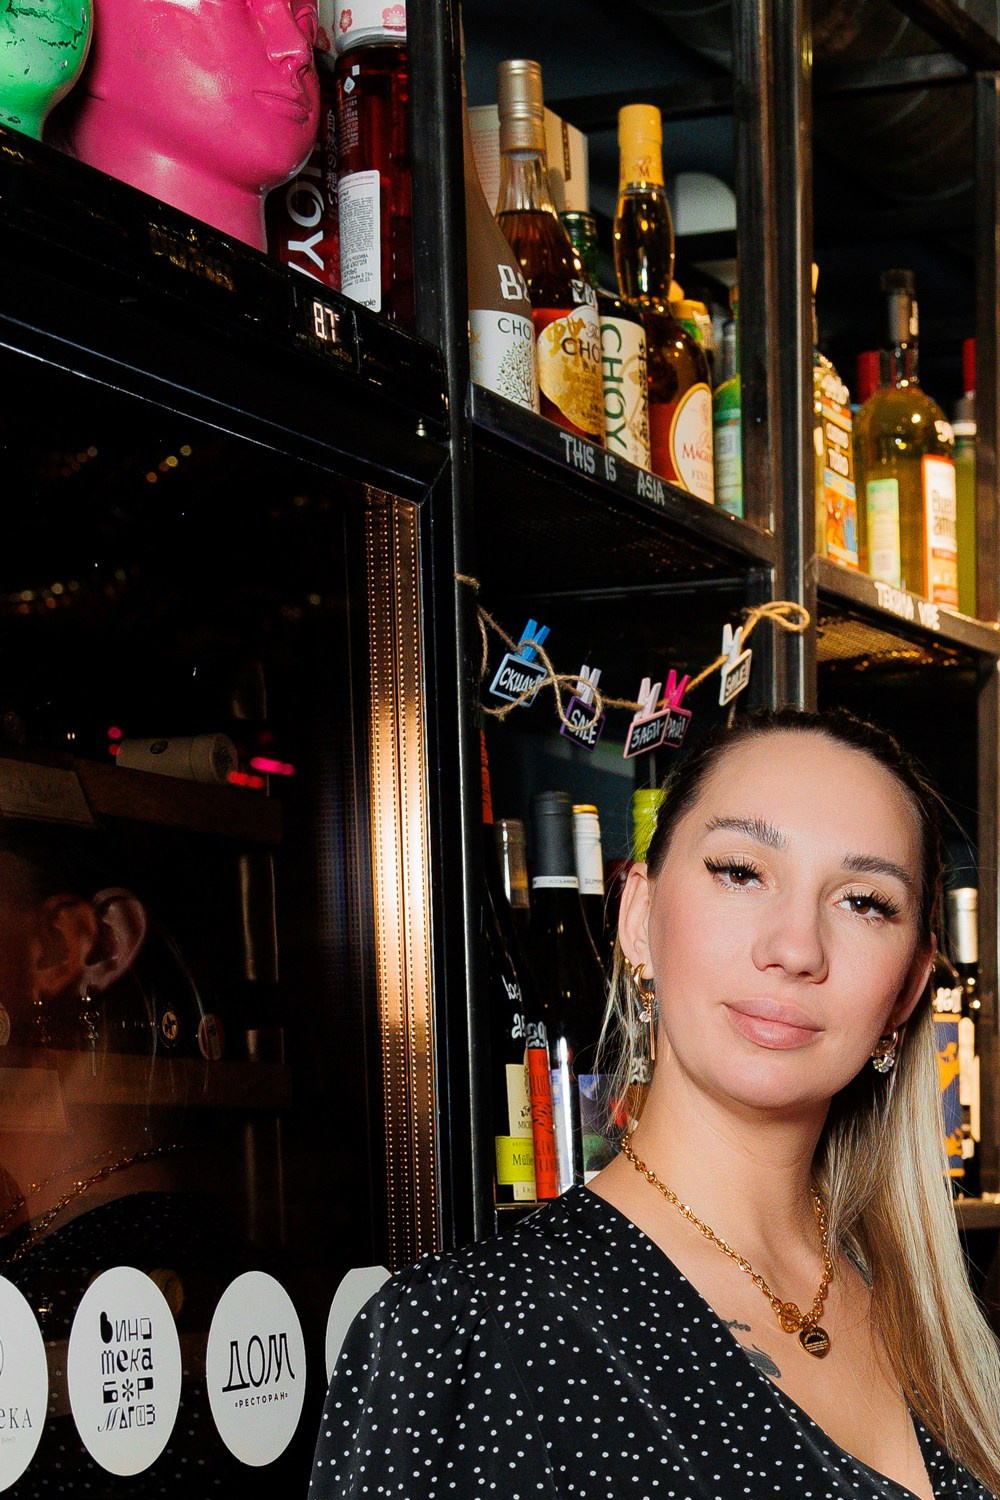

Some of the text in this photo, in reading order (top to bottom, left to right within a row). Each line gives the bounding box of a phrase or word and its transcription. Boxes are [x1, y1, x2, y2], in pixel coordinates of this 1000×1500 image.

[497, 317, 532, 341] CHO
[561, 337, 601, 363] CHO
[560, 432, 667, 506] THIS IS ASIA
[512, 1152, 536, 1167] Mülle
[222, 1332, 296, 1393] ДОМ
